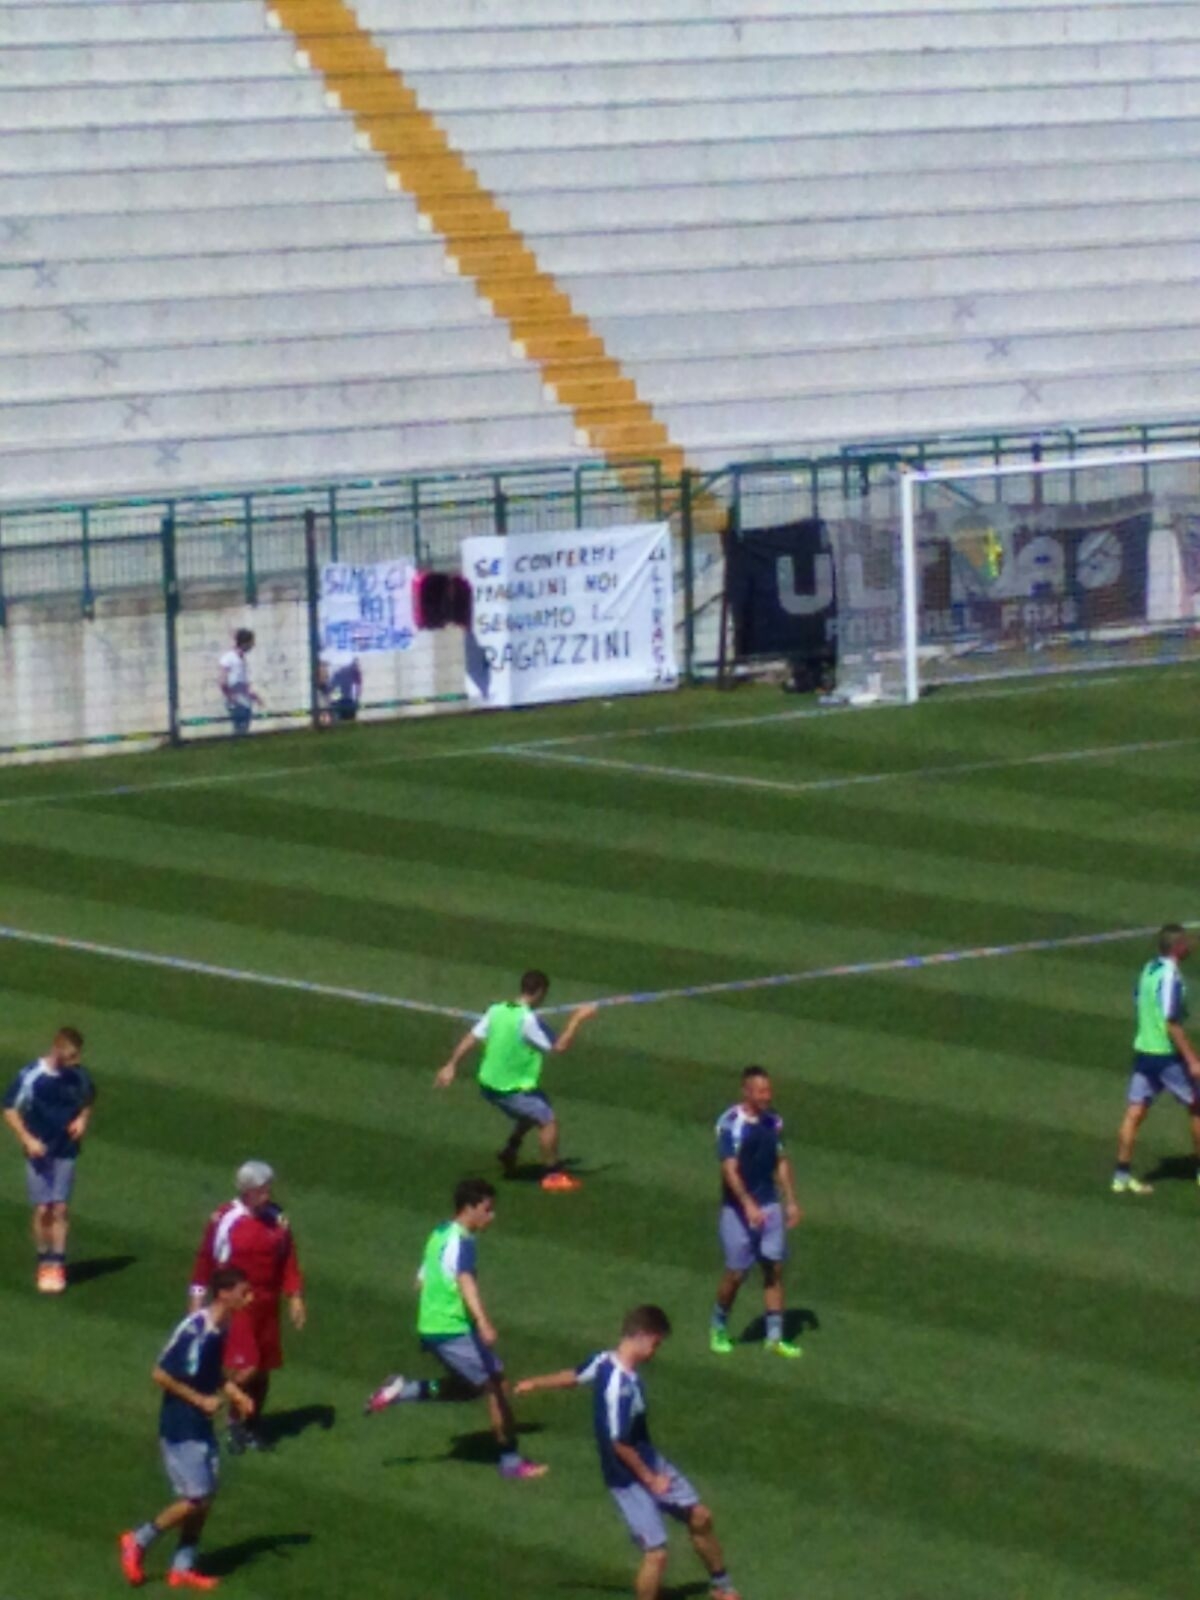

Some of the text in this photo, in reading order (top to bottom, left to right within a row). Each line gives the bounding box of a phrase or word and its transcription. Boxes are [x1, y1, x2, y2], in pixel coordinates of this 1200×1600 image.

[474, 546, 615, 578] SE CONFERMI
[776, 526, 1124, 615] ULAS
[484, 630, 630, 670] RAGAZZINI
